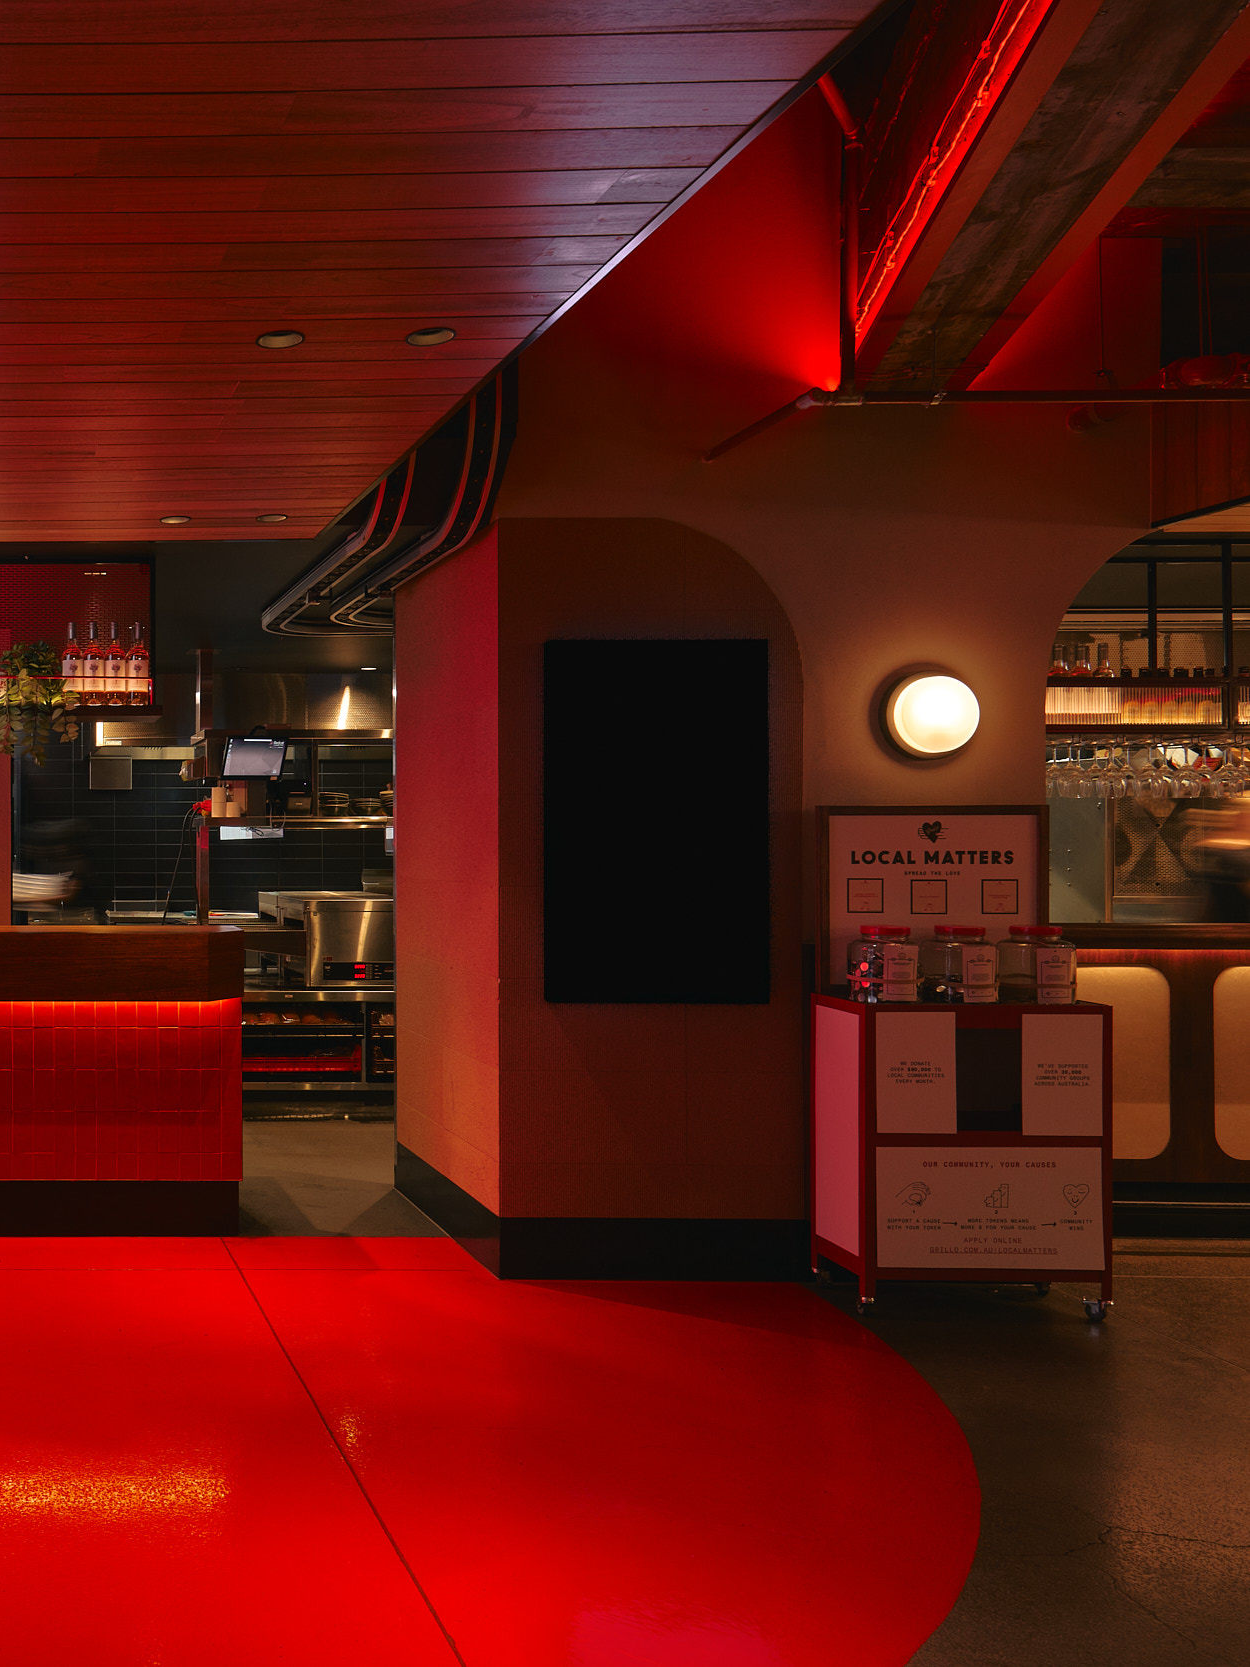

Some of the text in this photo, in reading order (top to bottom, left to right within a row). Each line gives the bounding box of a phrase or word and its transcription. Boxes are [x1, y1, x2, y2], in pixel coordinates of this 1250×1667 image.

[851, 850, 1014, 865] LOCAL MATTERS
[943, 1161, 994, 1169] COMMUNITY,
